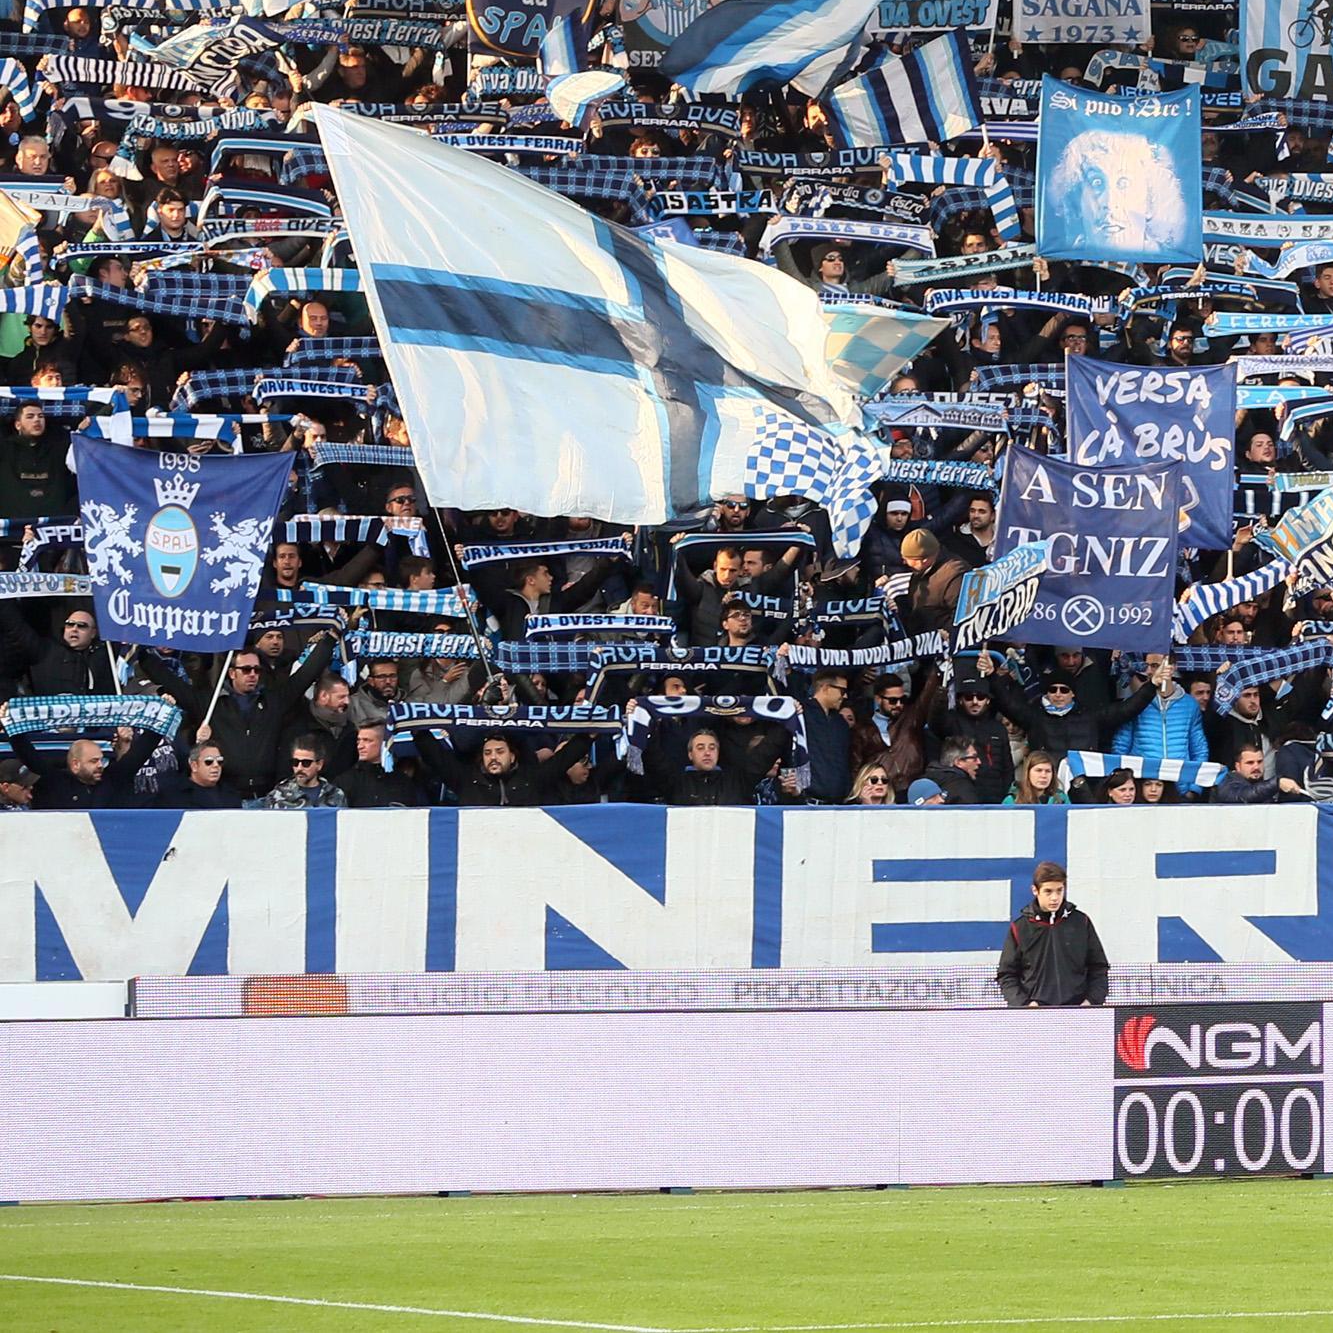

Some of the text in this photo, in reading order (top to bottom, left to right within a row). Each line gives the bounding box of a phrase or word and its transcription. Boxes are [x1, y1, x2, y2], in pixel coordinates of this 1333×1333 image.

[879, 1, 987, 27] DA OVEST
[1053, 25, 1115, 43] 1973
[633, 118, 699, 128] FERRARA
[1095, 371, 1212, 408] VERSA
[158, 451, 201, 471] 1998
[1020, 465, 1169, 510] A SEN
[108, 588, 240, 638] Copparo
[1108, 606, 1152, 625] 1992
[734, 978, 969, 1004] PROGETTAZIONE
[1145, 1021, 1321, 1067] NGM
[1116, 1087, 1321, 1175] 00:00
